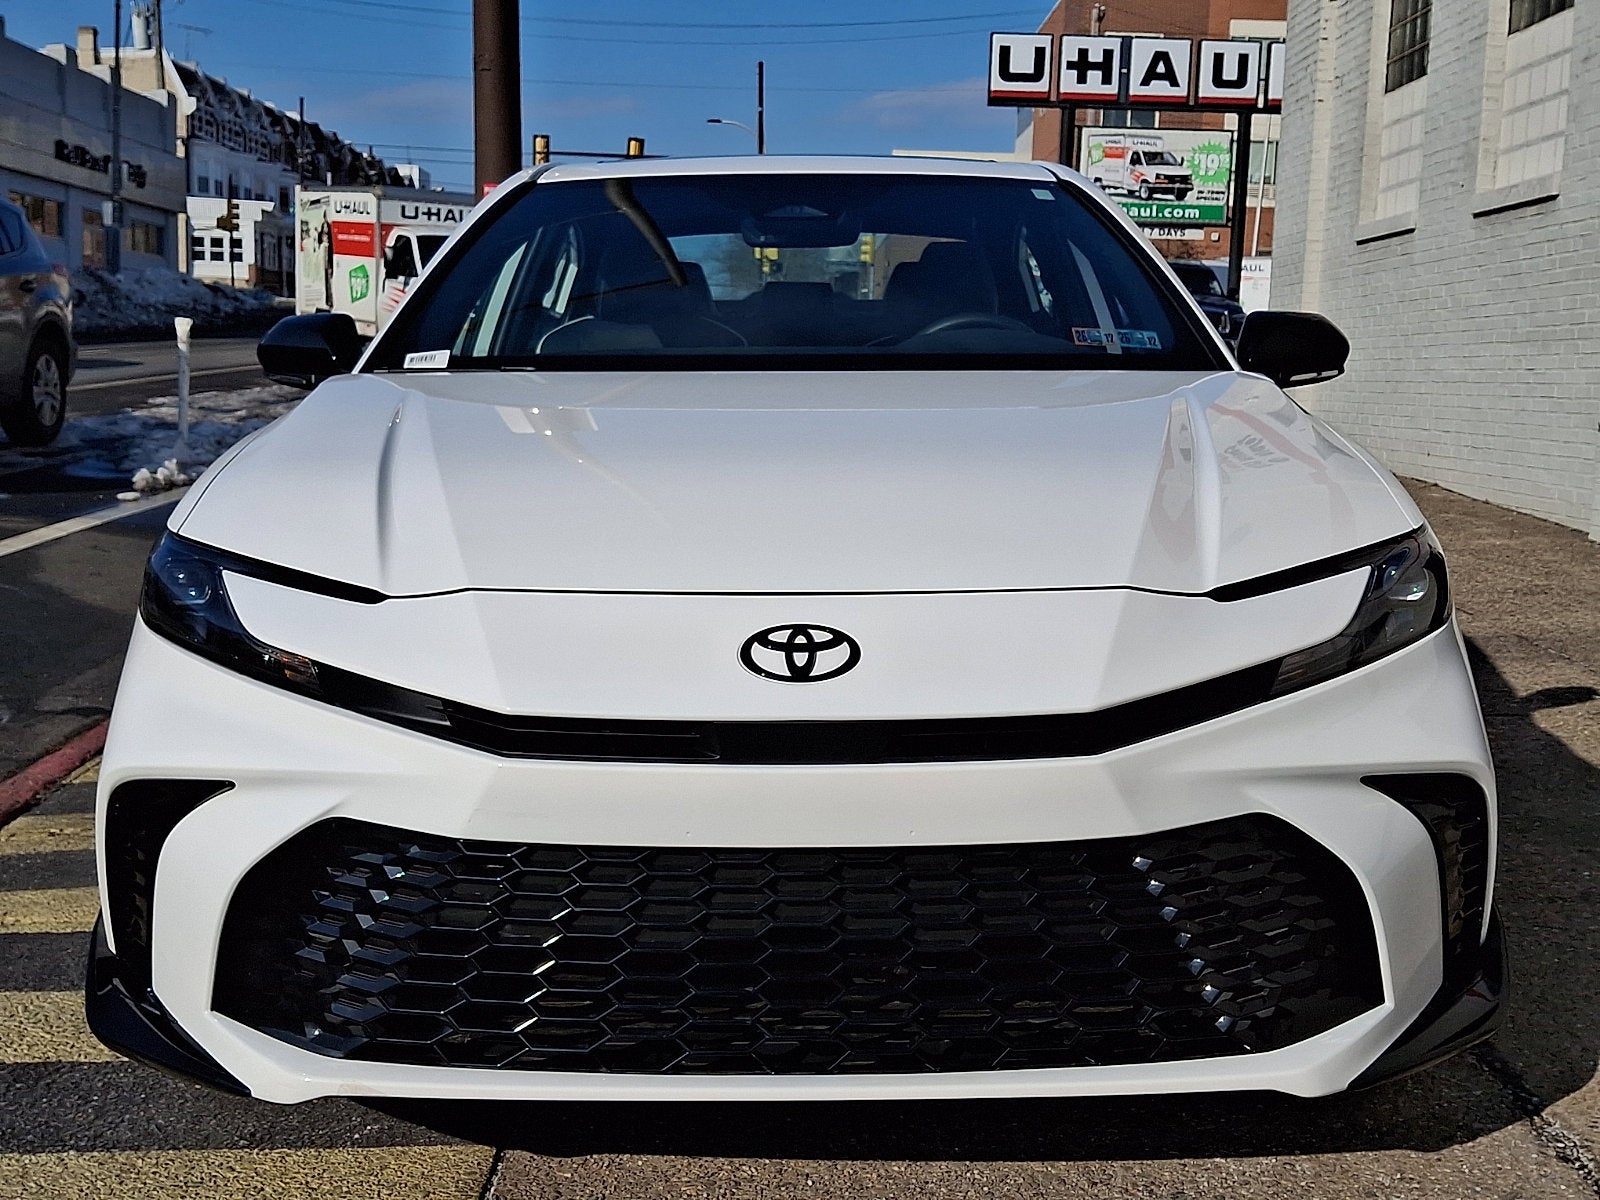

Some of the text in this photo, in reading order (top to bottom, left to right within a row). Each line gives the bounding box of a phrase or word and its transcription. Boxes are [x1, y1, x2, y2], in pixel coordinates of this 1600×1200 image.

[999, 44, 1250, 90] U-HAU
[1119, 203, 1200, 219] haul.com
[1158, 227, 1186, 237] DAYS
